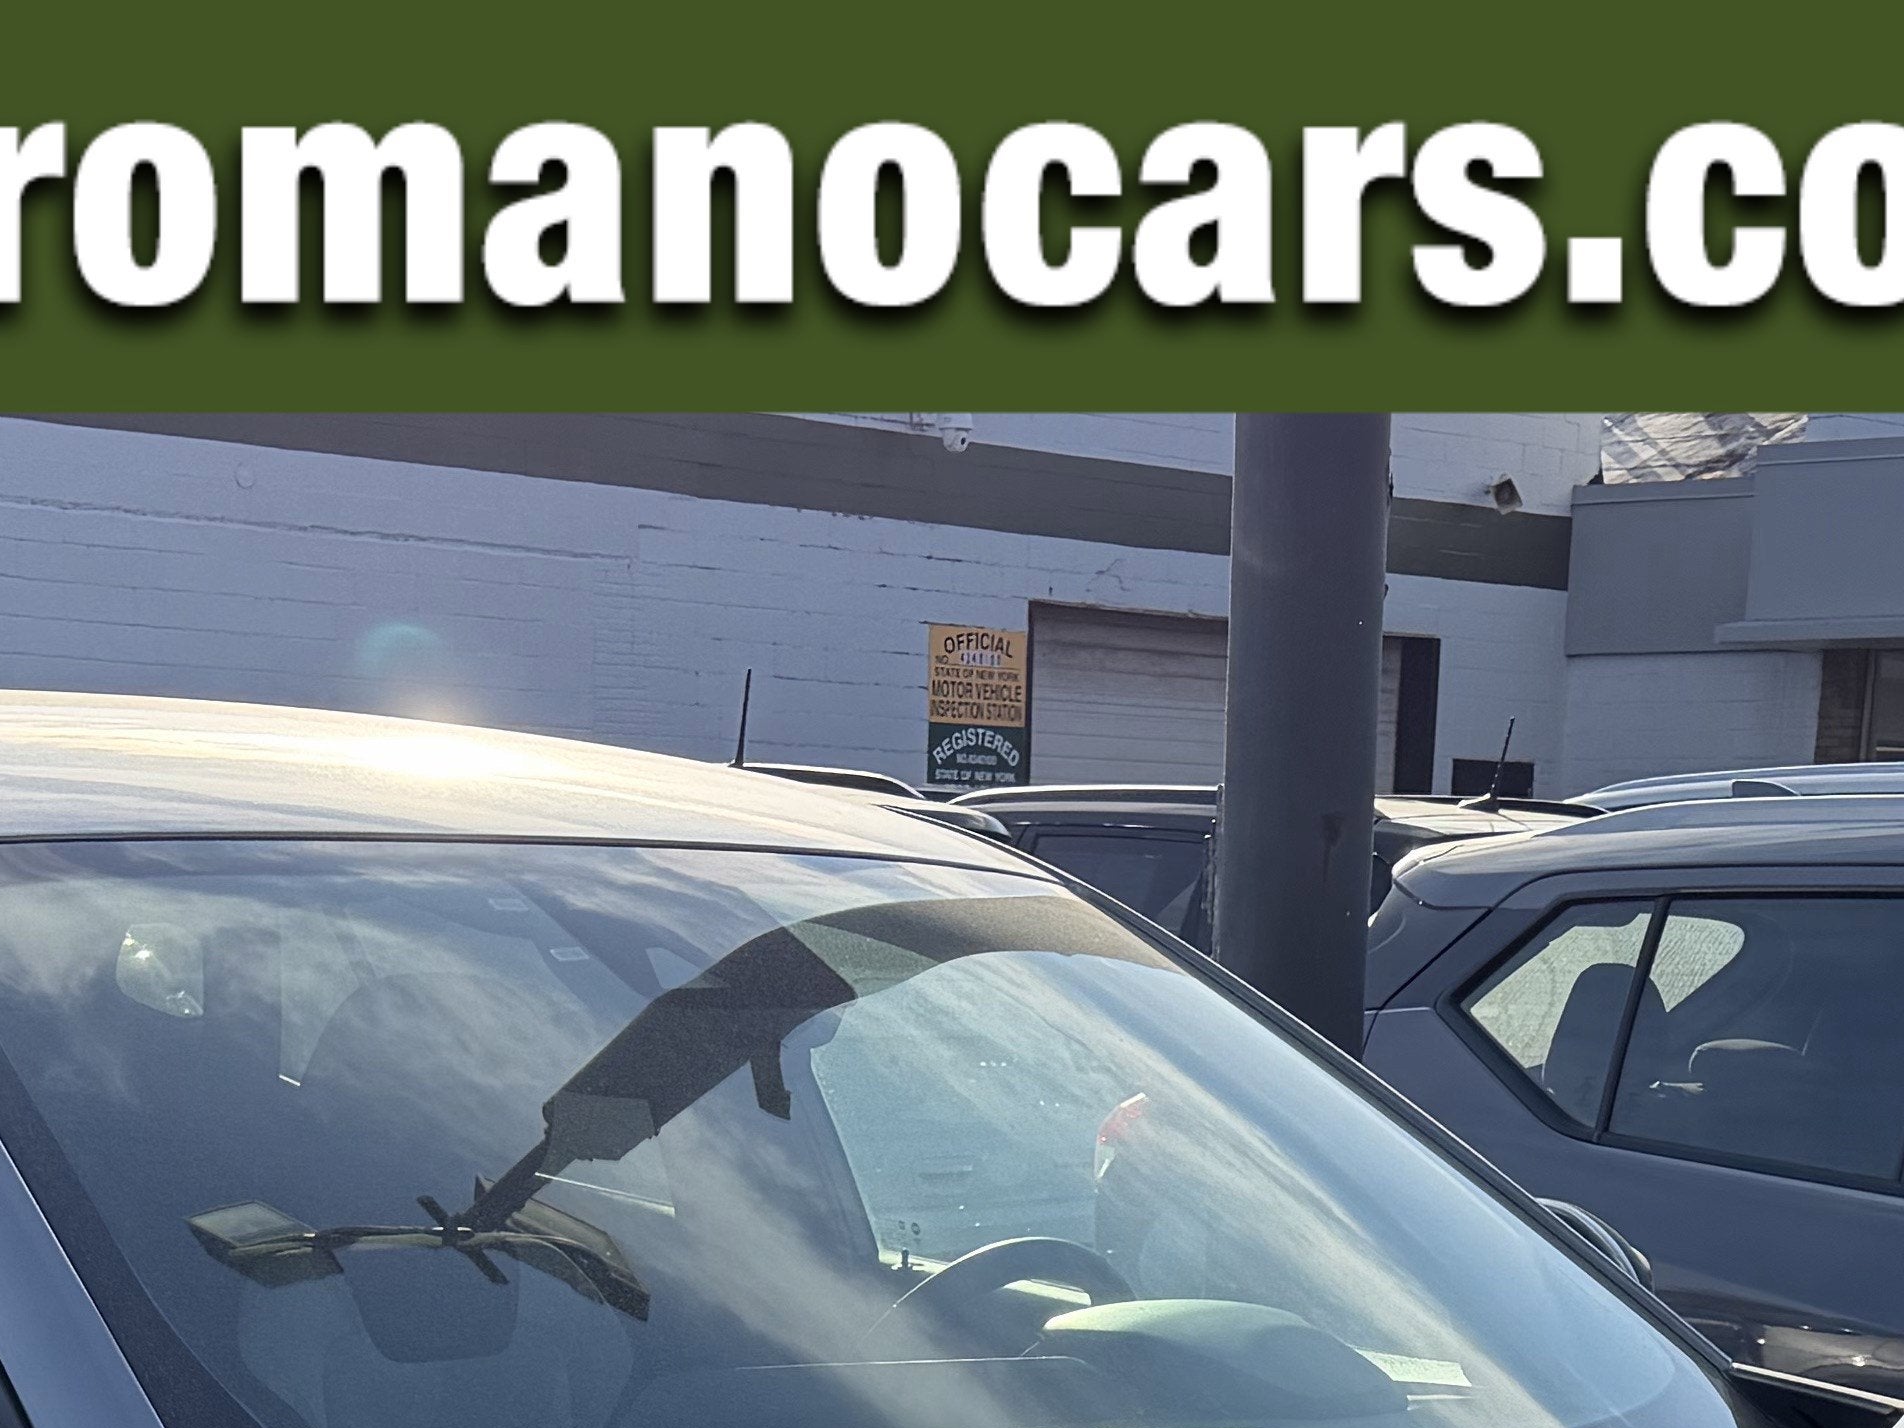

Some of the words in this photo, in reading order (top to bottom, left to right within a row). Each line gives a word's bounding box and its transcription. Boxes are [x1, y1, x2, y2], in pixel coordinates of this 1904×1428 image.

[943, 632, 1013, 658] OFFICIAL
[934, 667, 960, 678] STATE
[932, 679, 973, 699] MOTOR
[976, 683, 1022, 702] VEHICLE
[930, 700, 985, 720] INSPECTION
[986, 702, 1022, 720] STATION
[932, 728, 1020, 766] REGISTERED
